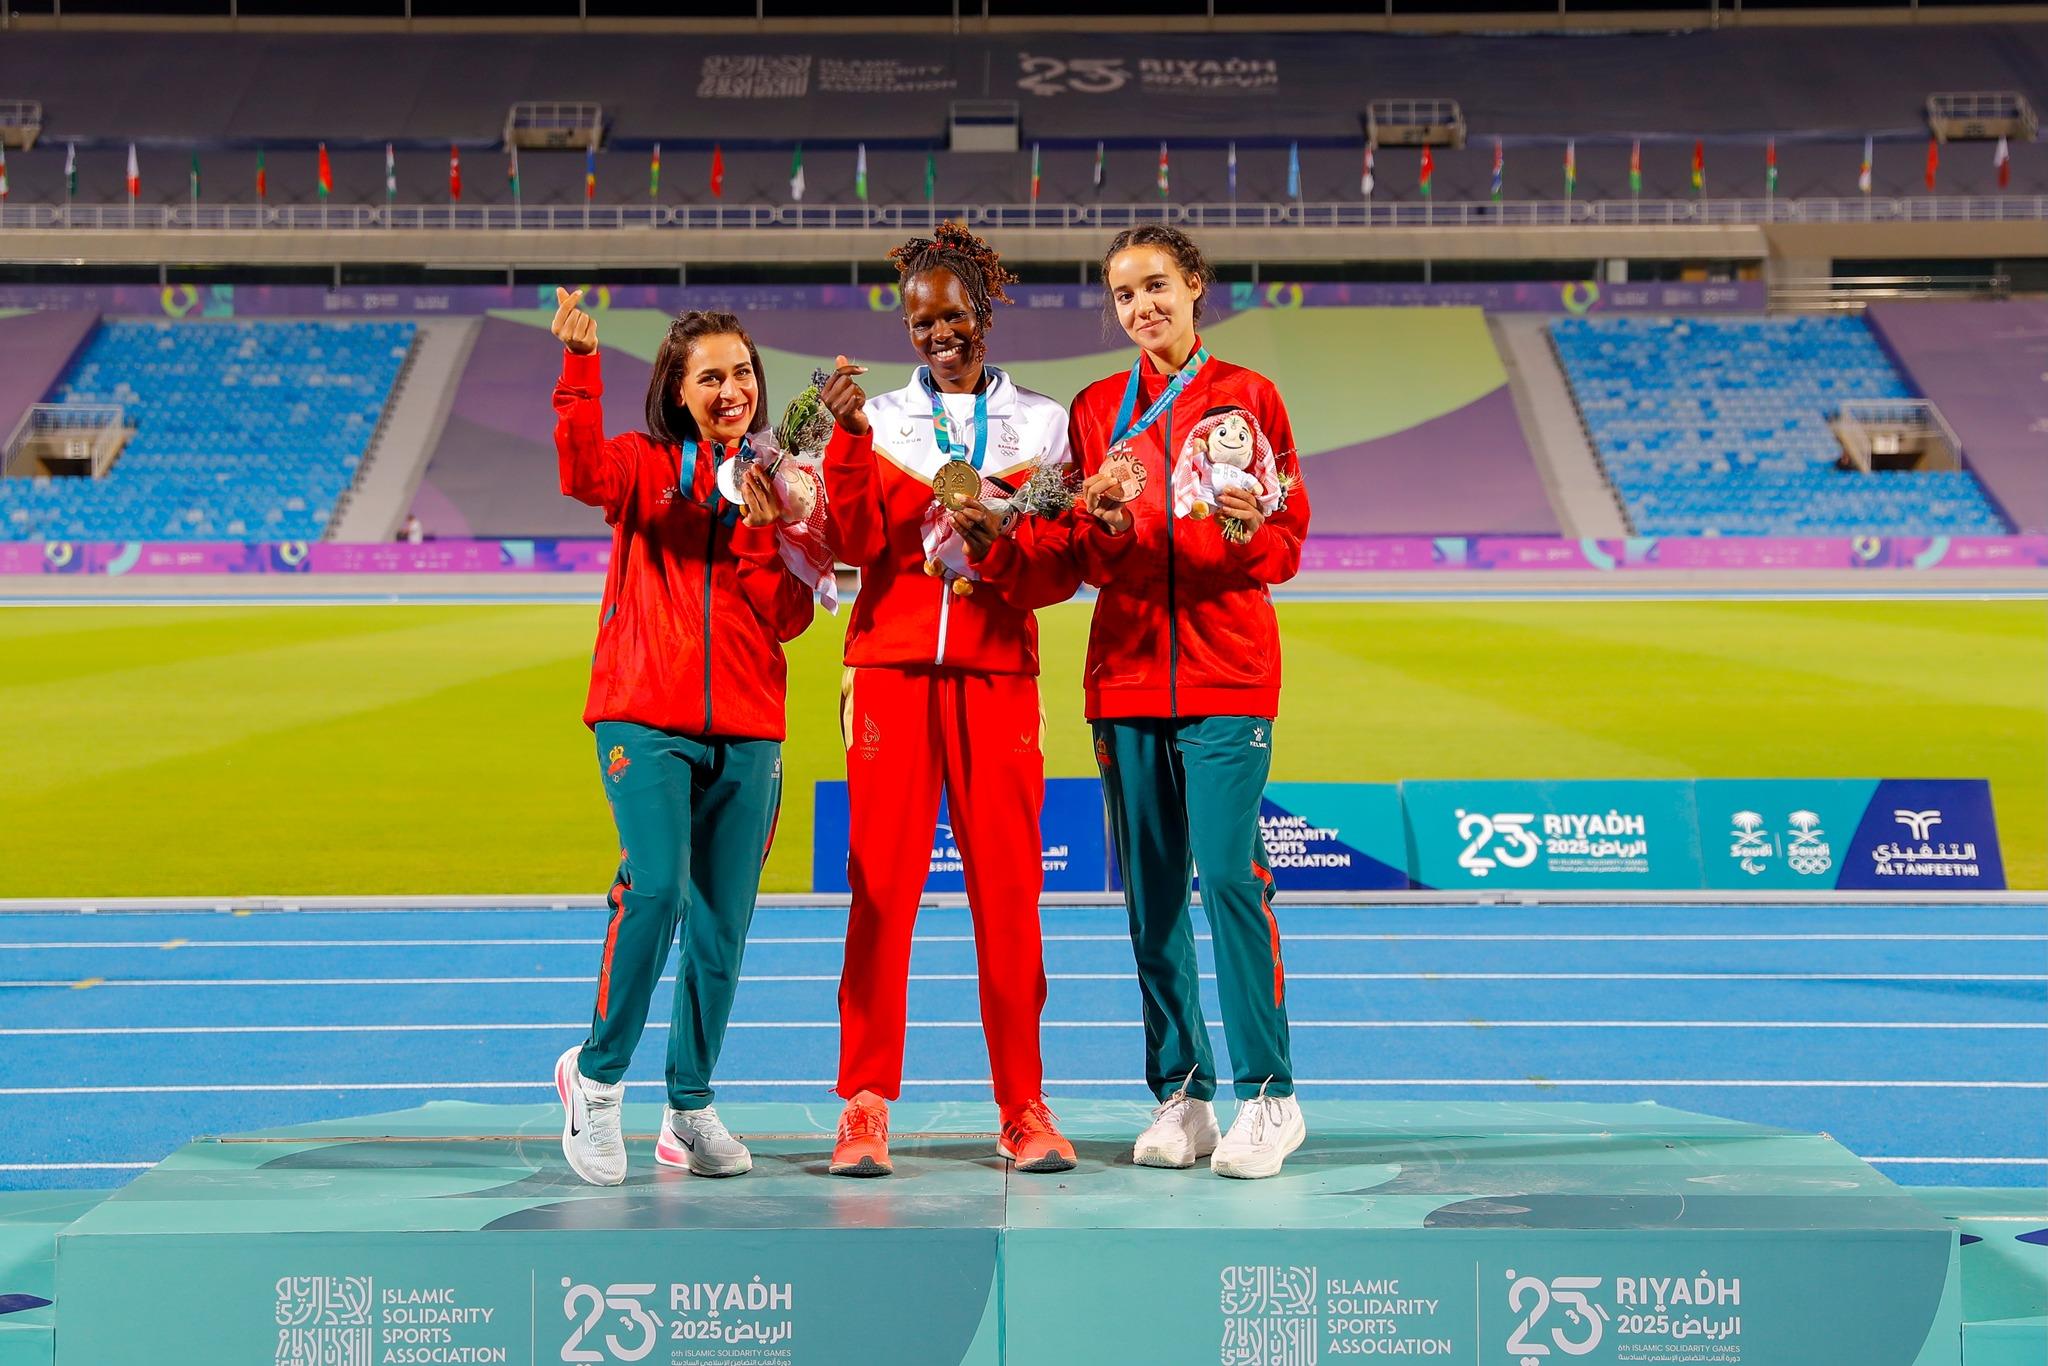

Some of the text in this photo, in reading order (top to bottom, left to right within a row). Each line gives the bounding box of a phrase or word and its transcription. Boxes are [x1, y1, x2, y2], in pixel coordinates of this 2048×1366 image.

[1017, 53, 1131, 96] 25
[1138, 58, 1278, 78] RIYADH
[1259, 816, 1307, 829] LAMIC
[1543, 810, 1645, 838] RIYADH
[1260, 828, 1339, 841] OLIDARITY
[1455, 809, 1543, 877] 25
[1546, 839, 1589, 854] 2025
[1590, 839, 1647, 858] الرياض
[1730, 842, 1773, 857] Saudi
[1787, 842, 1830, 857] Saudi
[1872, 842, 1977, 863] التنفيذي
[1041, 860, 1068, 871] CITY
[1269, 854, 1351, 868] SOCIATION
[1327, 1279, 1399, 1295] ISLAMIC
[1616, 1268, 1740, 1312] RIYADH
[382, 1288, 455, 1304] ISLAMIC
[670, 1274, 792, 1318] RIYADH
[1327, 1299, 1439, 1315] SOLIDARITY
[382, 1308, 495, 1324] SOLIDARITY
[560, 1276, 664, 1366] 25
[1505, 1269, 1610, 1366] 25
[1617, 1314, 1670, 1334] 2025
[670, 1320, 722, 1340] 2025
[724, 1319, 792, 1345] الرياض
[1327, 1318, 1397, 1334] SPORTS
[1671, 1313, 1741, 1340] الرياض
[382, 1328, 452, 1344] SPORTS
[685, 1349, 716, 1357] ISLAMIC
[717, 1349, 762, 1357] SOLIDARITY
[763, 1349, 792, 1357] GAMES
[1327, 1338, 1452, 1354] ASSOCIATION
[1632, 1344, 1664, 1352] ISLAMIC
[1664, 1344, 1711, 1352] SOLIDARITY
[1711, 1344, 1741, 1353] GAMES
[382, 1347, 507, 1364] ASSOCIATION
